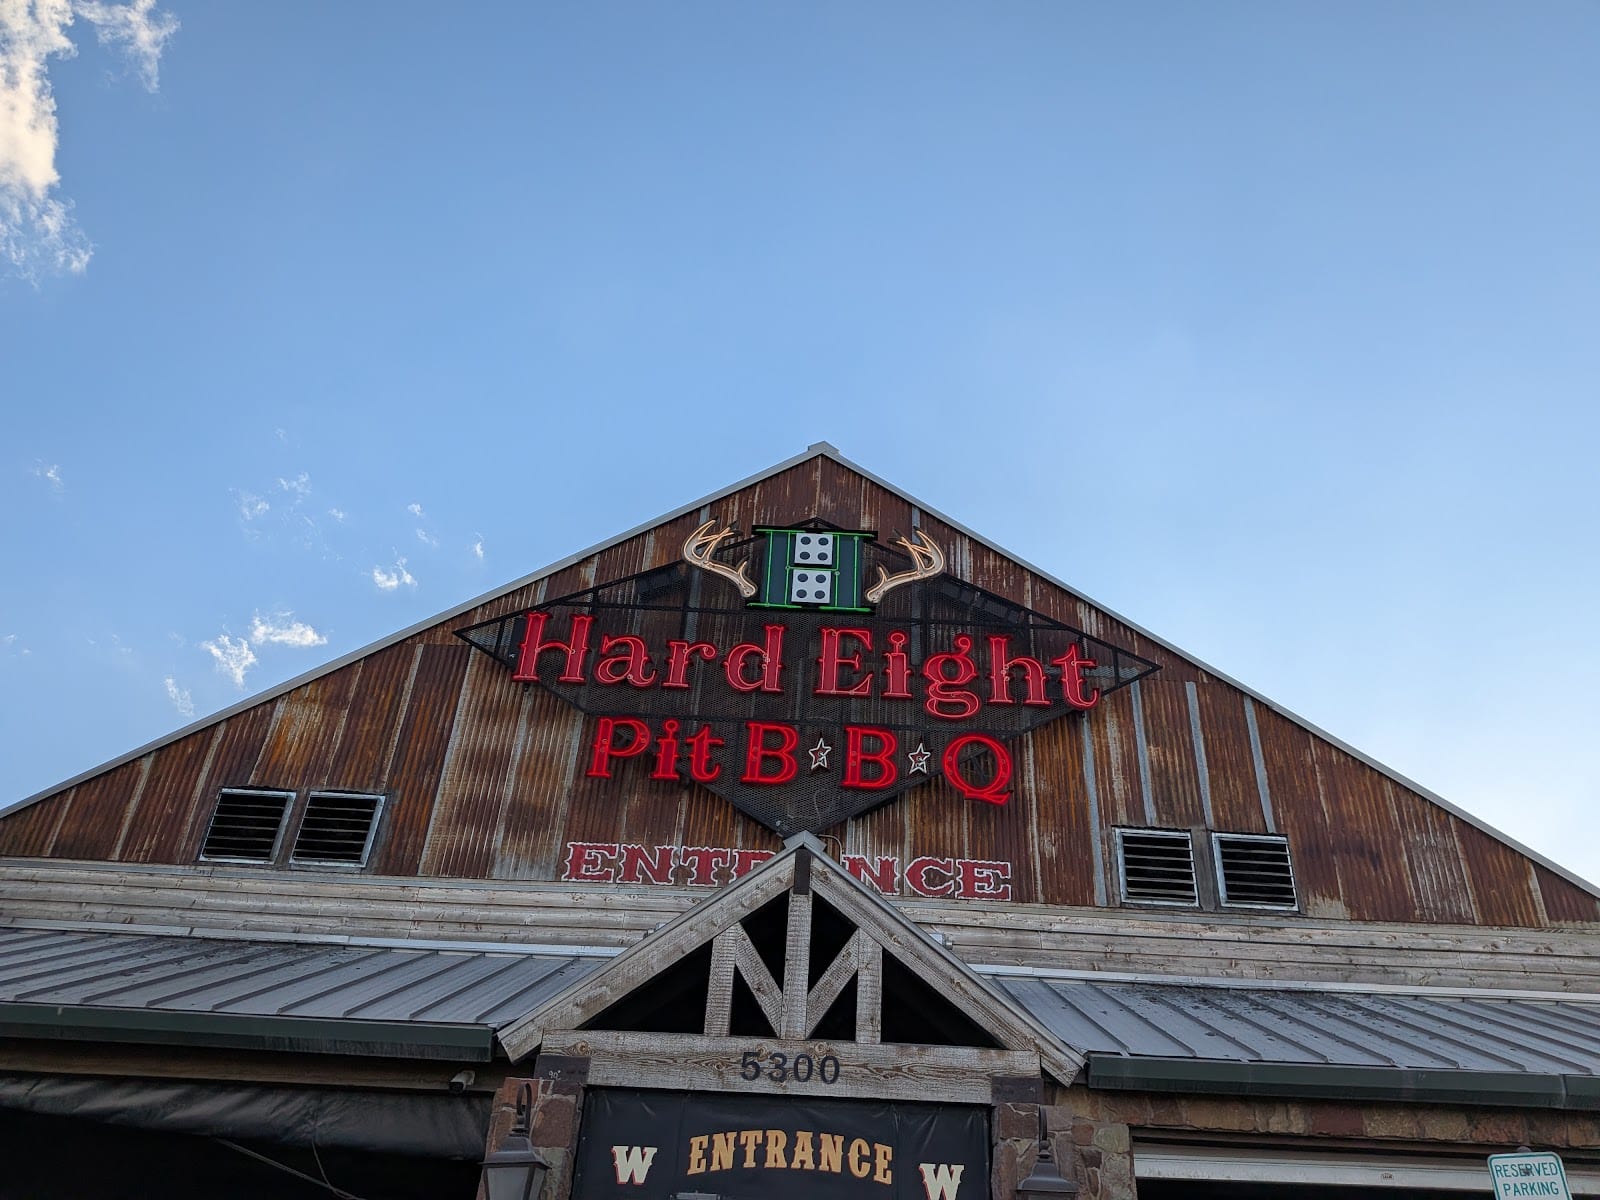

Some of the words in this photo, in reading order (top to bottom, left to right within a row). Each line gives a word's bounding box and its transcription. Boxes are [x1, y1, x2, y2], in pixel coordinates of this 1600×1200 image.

[512, 611, 786, 692] Hard
[813, 625, 1099, 719] Eight
[586, 716, 724, 783] Pit
[561, 842, 1012, 901] ENTNCE
[740, 1051, 840, 1084] 5300
[611, 1146, 658, 1185] W
[687, 1130, 893, 1185] ENTRANCE
[1494, 1162, 1558, 1178] RESERVED
[1503, 1182, 1559, 1197] PARKING
